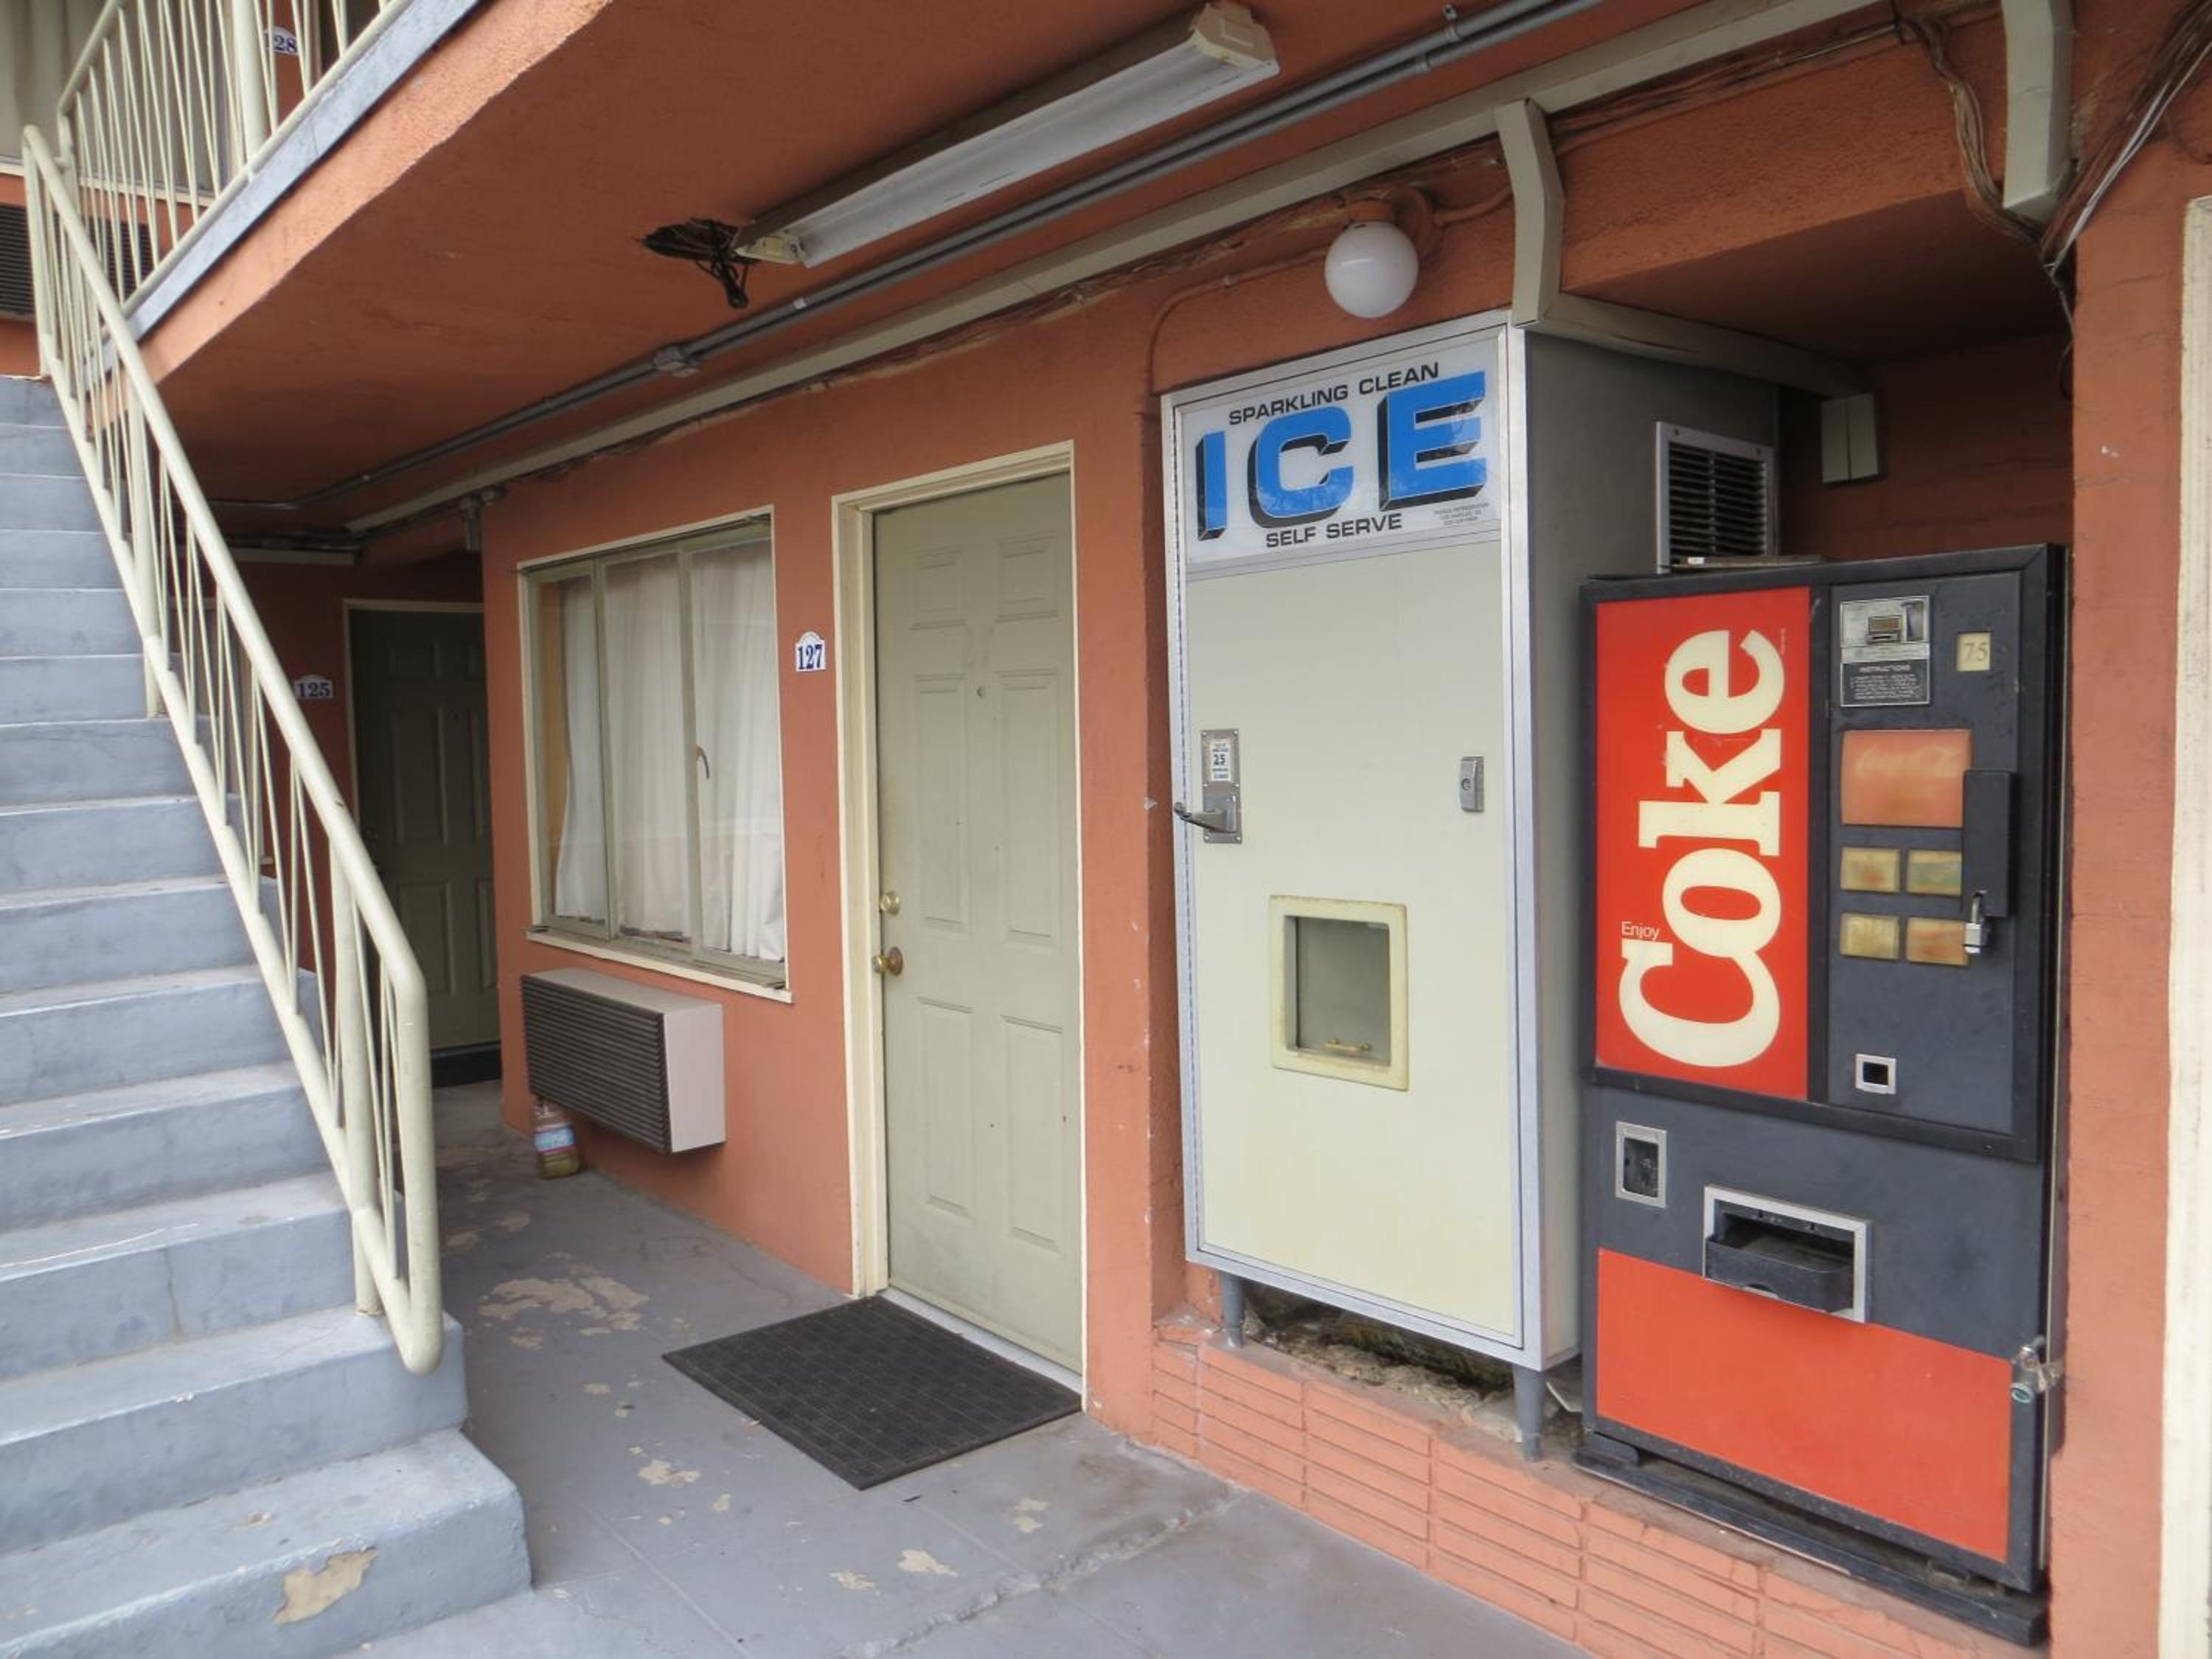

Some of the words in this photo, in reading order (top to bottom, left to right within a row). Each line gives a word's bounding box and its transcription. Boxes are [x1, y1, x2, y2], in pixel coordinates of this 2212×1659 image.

[1229, 385, 1348, 425] SPARKLING
[1359, 362, 1439, 395] CLEAN
[1195, 370, 1486, 541] ICE
[1266, 526, 1317, 548] SELF
[1326, 512, 1402, 539] SERVE
[798, 644, 823, 669] 127
[1963, 642, 1989, 662] 75
[299, 682, 331, 697] 125
[1618, 628, 1784, 1068] Coke
[1621, 921, 1660, 942] Enjoy
